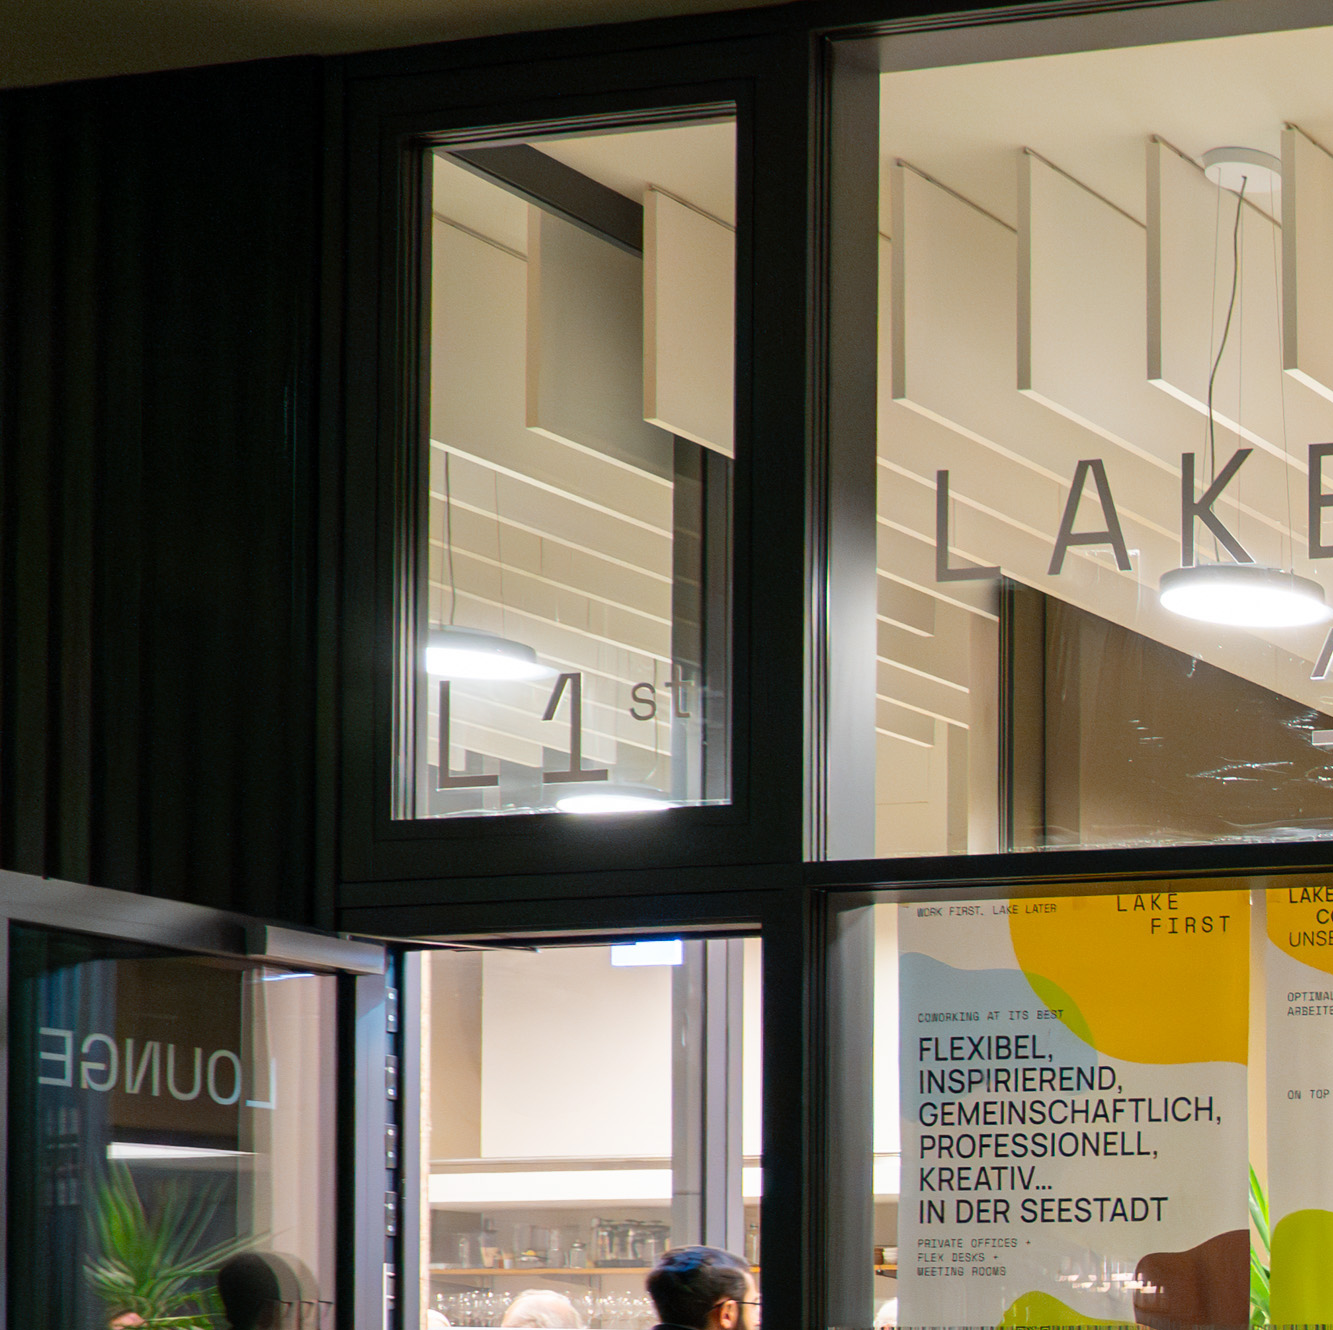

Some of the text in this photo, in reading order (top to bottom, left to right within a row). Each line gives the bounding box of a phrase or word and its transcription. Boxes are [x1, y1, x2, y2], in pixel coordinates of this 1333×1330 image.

[917, 907, 942, 917] WORK
[993, 905, 1018, 915] LAKE
[1025, 904, 1057, 913] LATER
[1117, 893, 1178, 911] LAKE
[1151, 915, 1230, 934] FIRST
[918, 1009, 1064, 1023] COWORKING AT ITS BEST
[919, 1034, 1053, 1062] FLEXIBEL,
[919, 1065, 1123, 1094] INSPIRIEREND,
[1288, 1089, 1330, 1100] ON TOP
[919, 1096, 1221, 1126] GEMEINSCHAFTLICH,
[919, 1131, 1158, 1159] PROFESSIONELL,
[919, 1165, 1052, 1191] KREATIV...
[919, 1196, 1168, 1224] IN DER SEESTADT
[917, 1238, 963, 1248] PRIVATE
[971, 1238, 1018, 1248] OFFICES
[917, 1252, 944, 1262] FLEX
[952, 1252, 985, 1262] DESKS
[917, 1266, 1006, 1276] MEETING ROOMS
